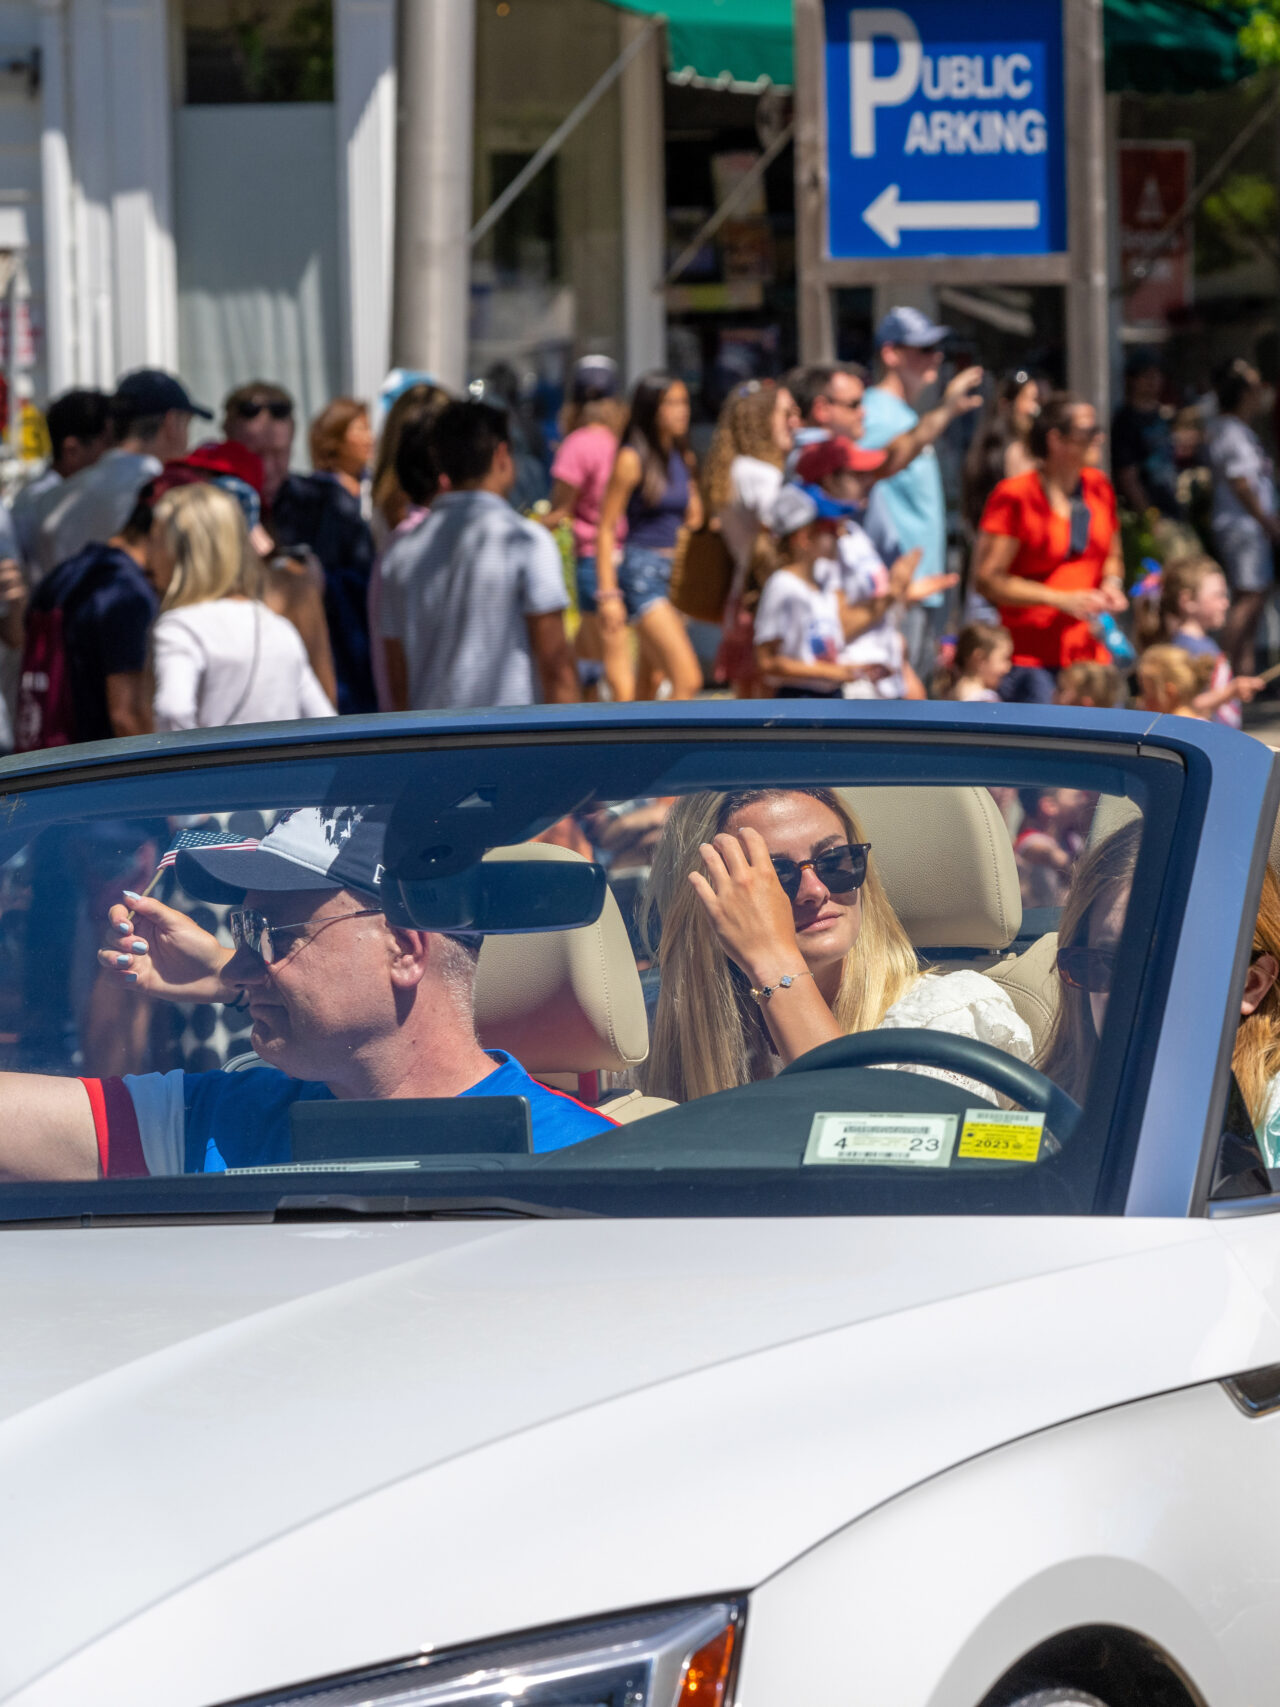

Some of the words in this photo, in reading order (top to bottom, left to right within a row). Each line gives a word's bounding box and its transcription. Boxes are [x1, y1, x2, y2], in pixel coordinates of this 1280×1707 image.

[833, 1137, 848, 1150] 4
[909, 1138, 940, 1151] 23
[975, 1139, 1010, 1150] 2023
